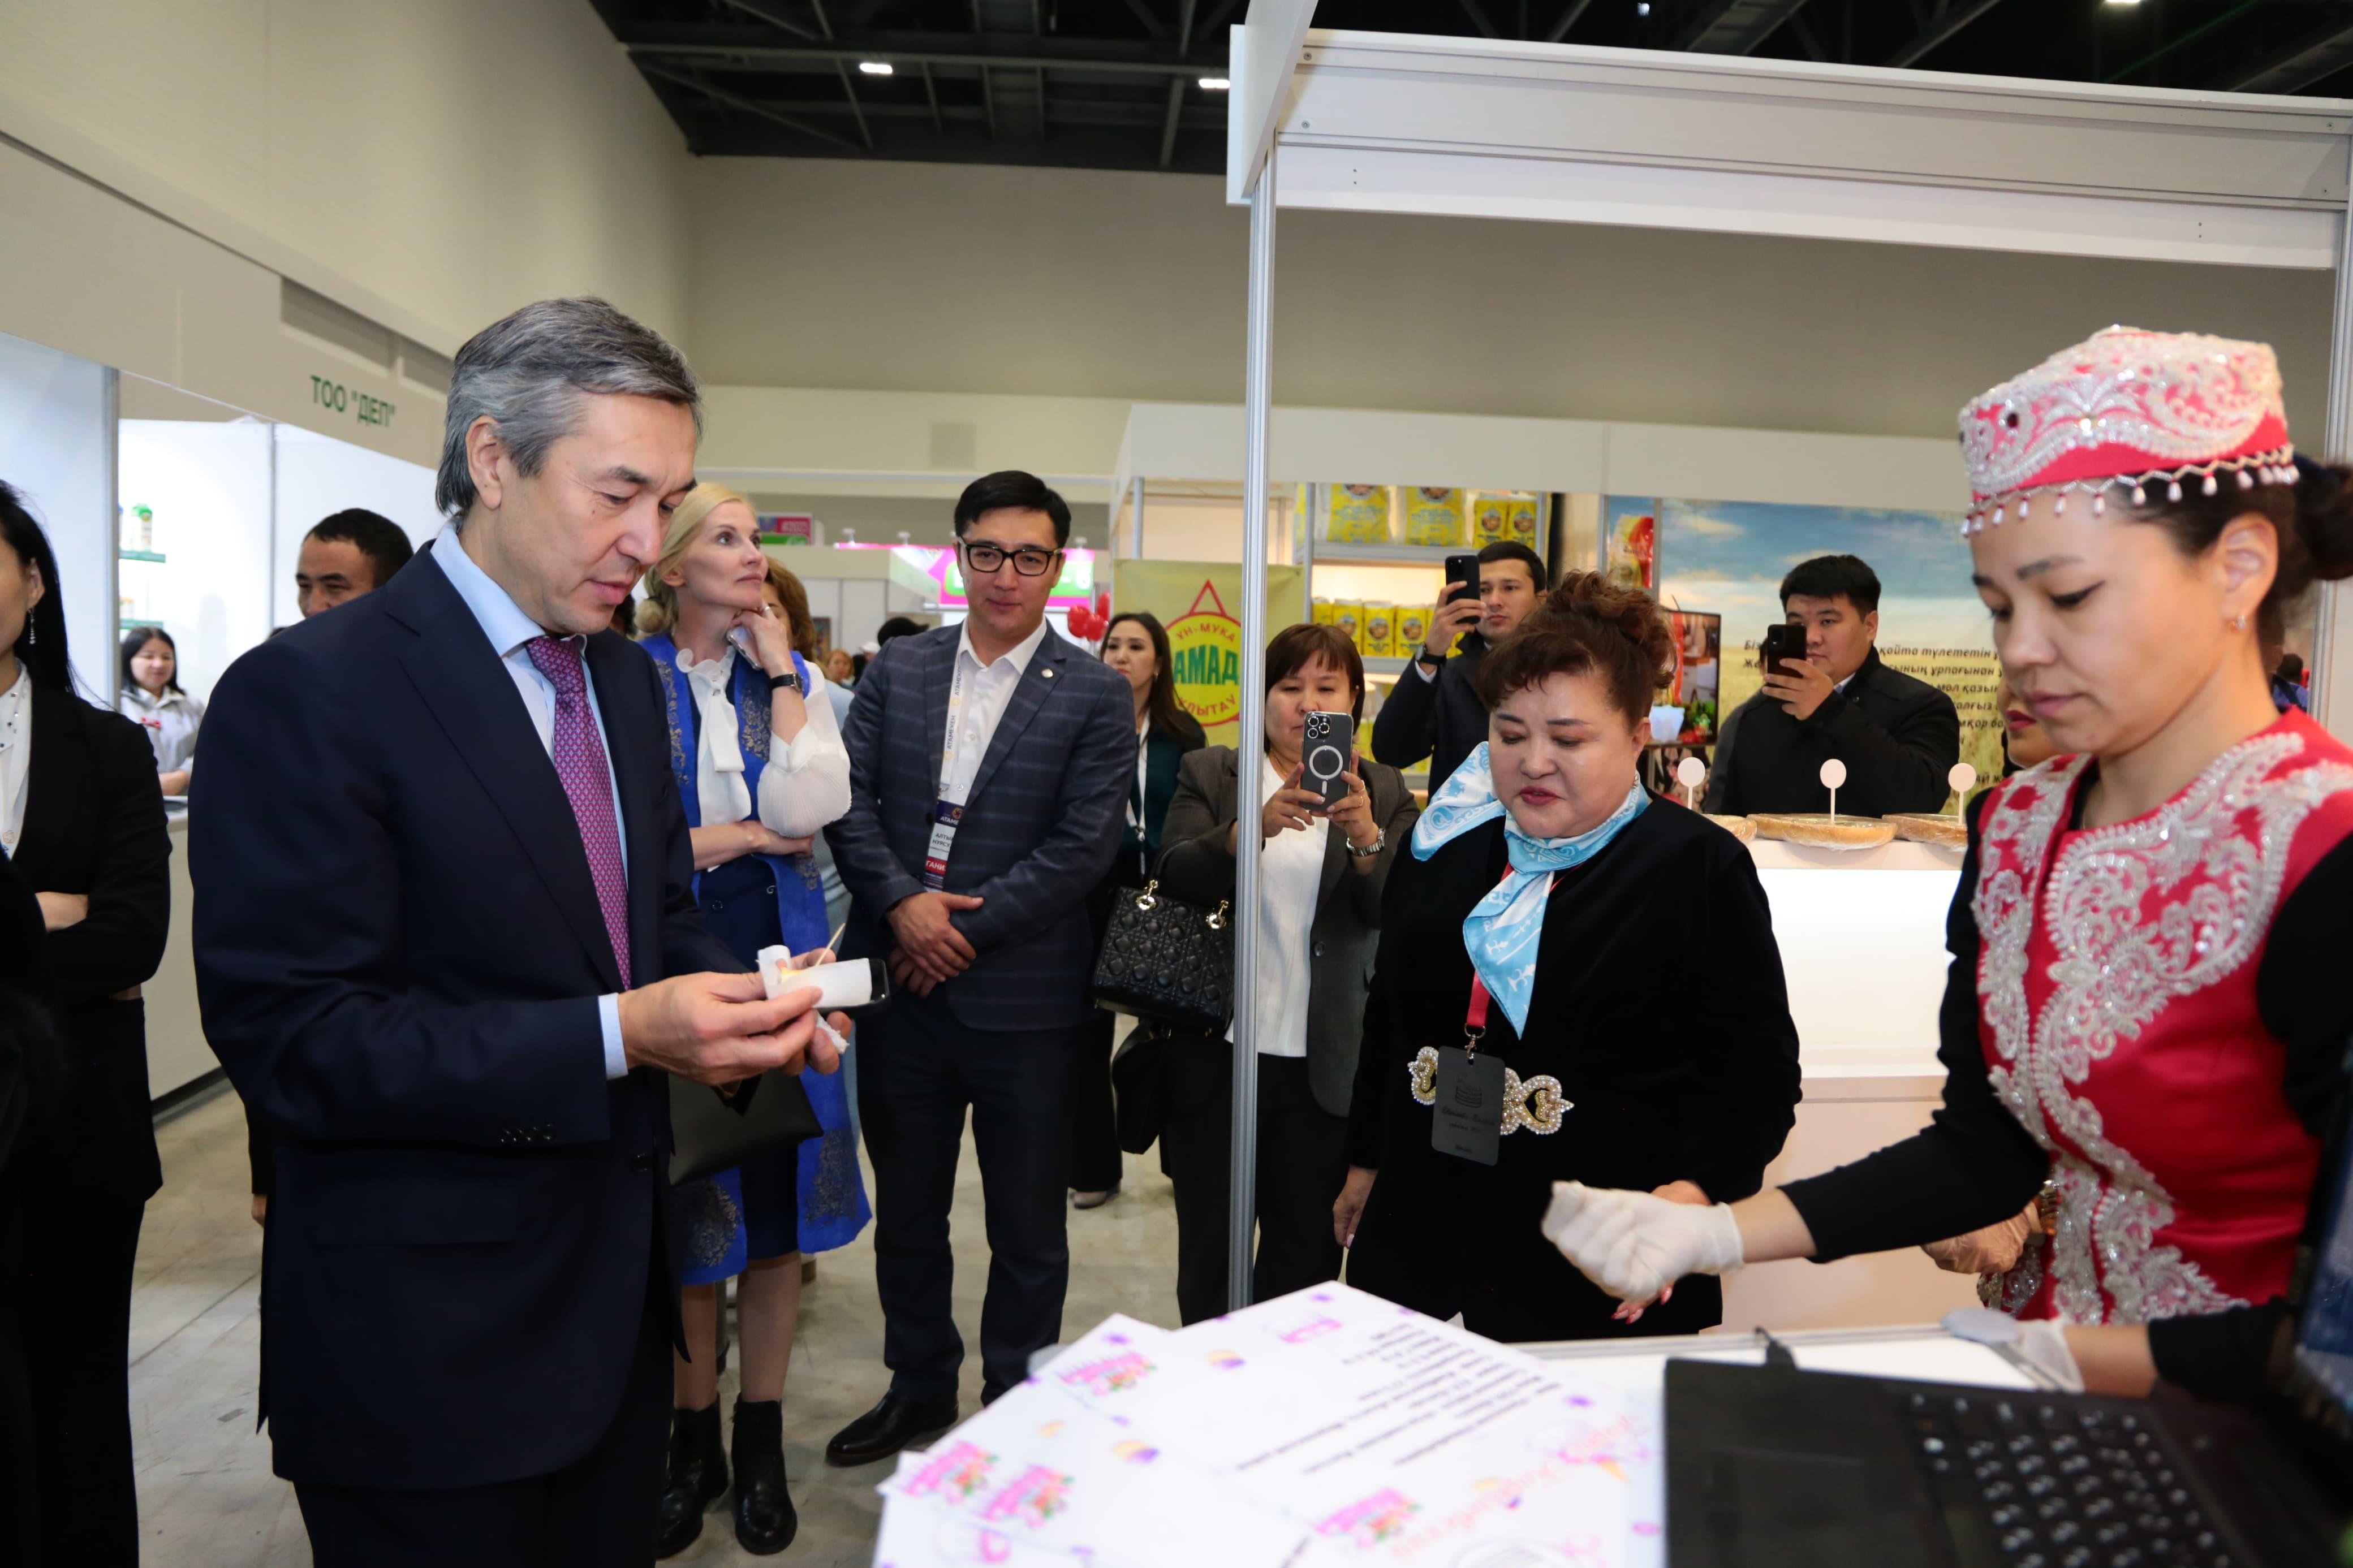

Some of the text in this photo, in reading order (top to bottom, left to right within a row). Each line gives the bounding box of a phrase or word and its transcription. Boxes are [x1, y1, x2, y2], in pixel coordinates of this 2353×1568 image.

[311, 375, 395, 427] ТОО "ДЕП"
[947, 715, 956, 749] АТАМЕКЕН
[940, 815, 959, 826] АТАМЕ
